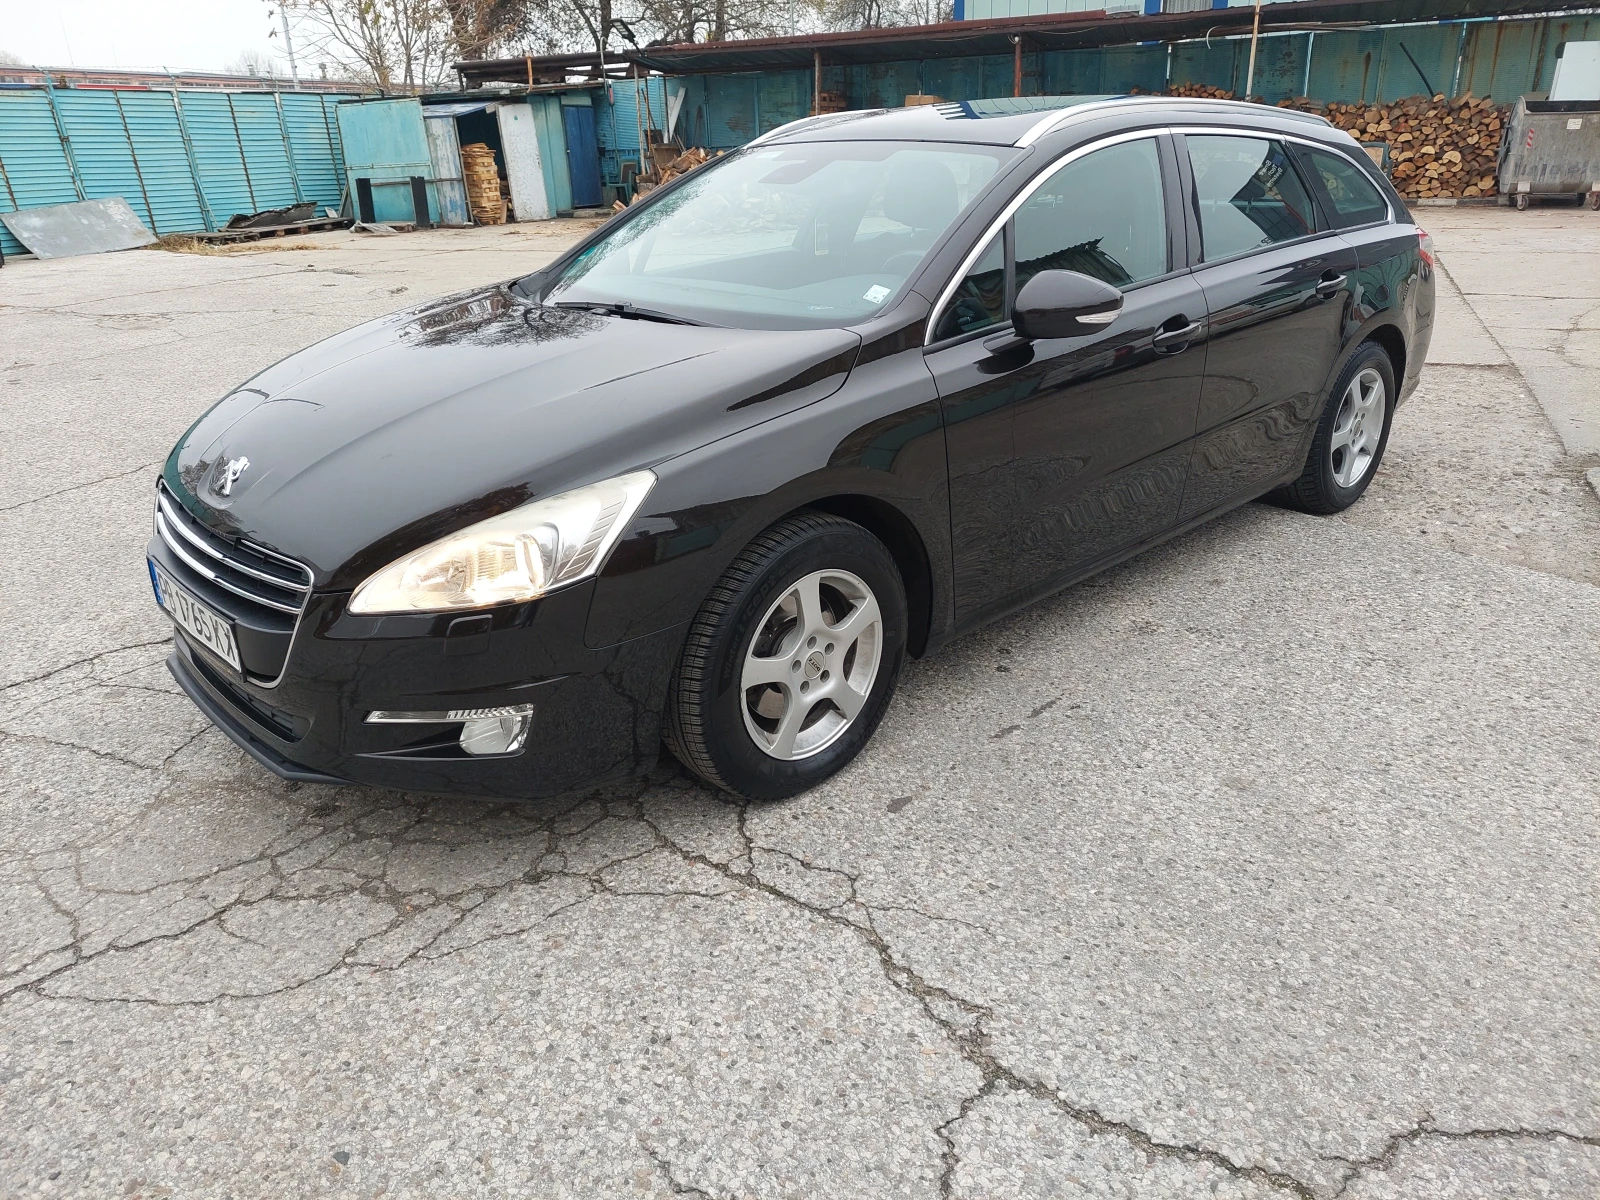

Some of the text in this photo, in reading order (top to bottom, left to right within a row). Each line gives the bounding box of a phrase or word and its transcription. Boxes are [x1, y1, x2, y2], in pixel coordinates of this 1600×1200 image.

[176, 590, 211, 642] 1765
[209, 615, 237, 663] KX
[808, 653, 821, 672] DOTZ
